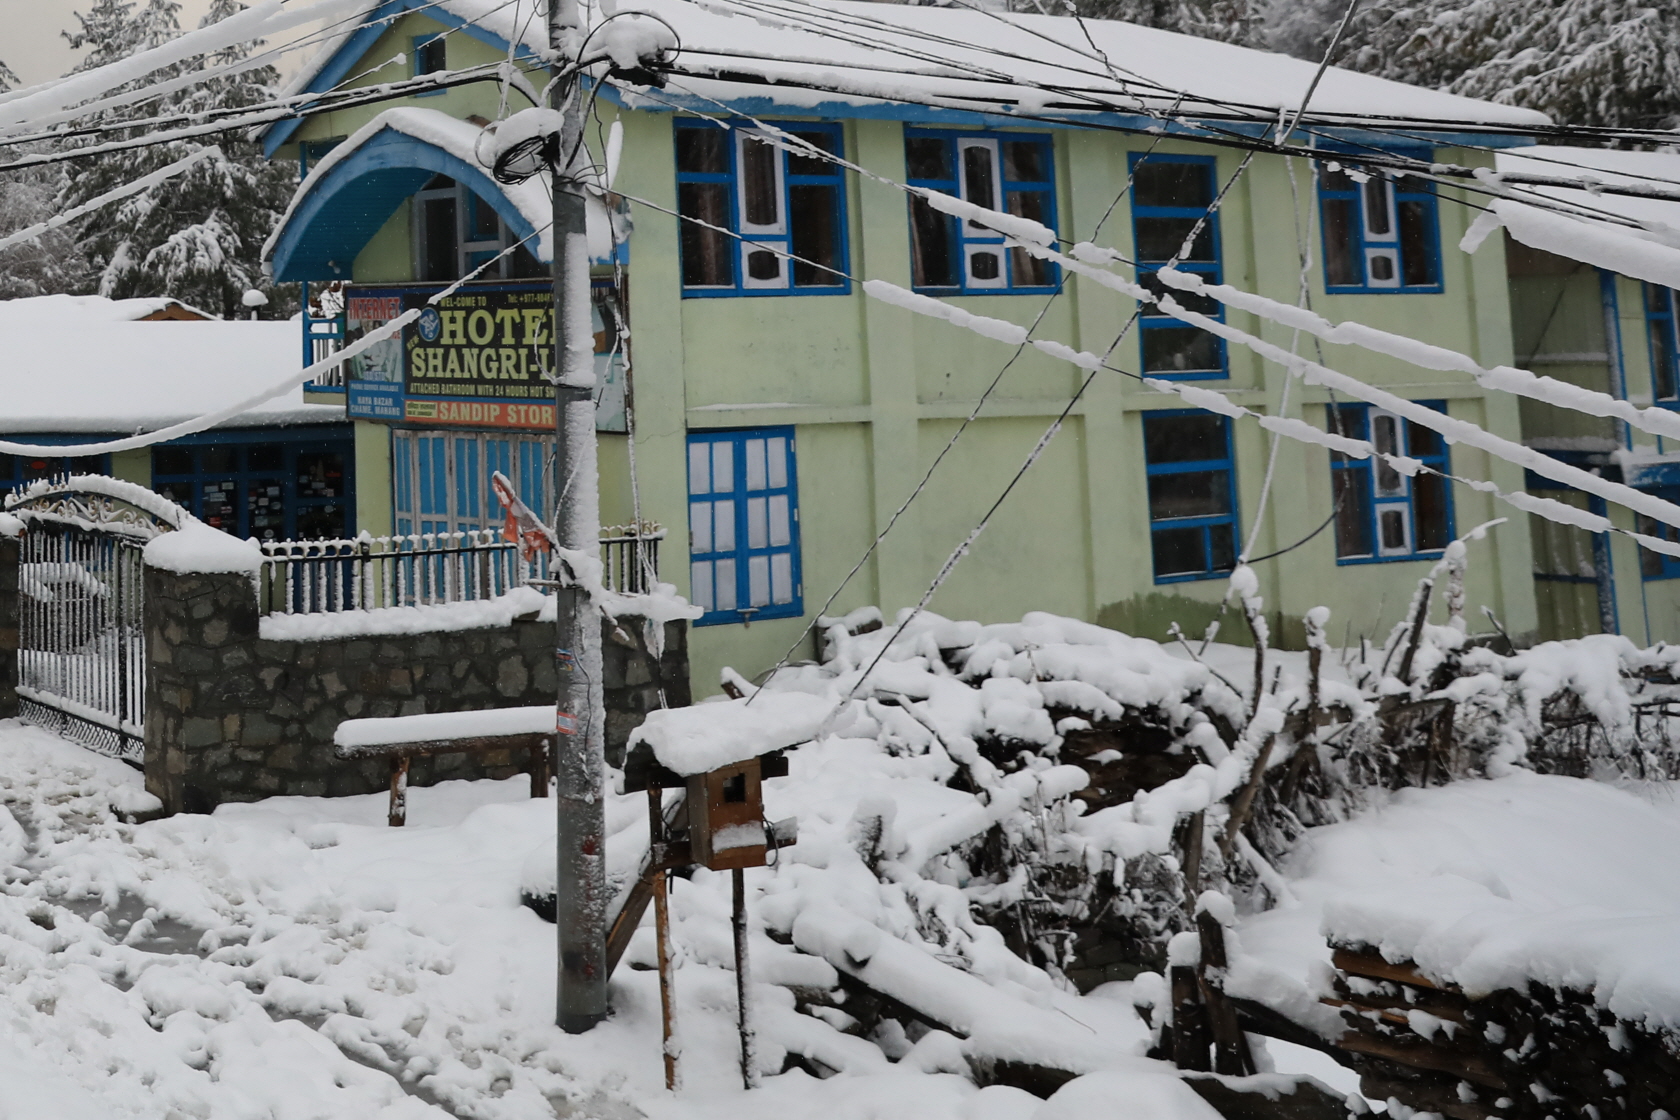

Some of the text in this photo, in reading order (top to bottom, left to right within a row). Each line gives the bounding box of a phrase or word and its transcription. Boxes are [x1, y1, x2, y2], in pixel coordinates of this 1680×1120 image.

[348, 296, 401, 320] INTERNET
[477, 296, 487, 307] TO
[411, 347, 556, 380] SHANGRI-L
[410, 382, 440, 395] ATTACHED
[441, 383, 476, 395] BATHROOM
[477, 384, 494, 396] WITH
[495, 385, 504, 396] 24
[505, 385, 529, 397] HOURS
[529, 385, 544, 398] HOT
[373, 397, 393, 406] BAZAR
[439, 402, 554, 425] SANDIP STOR
